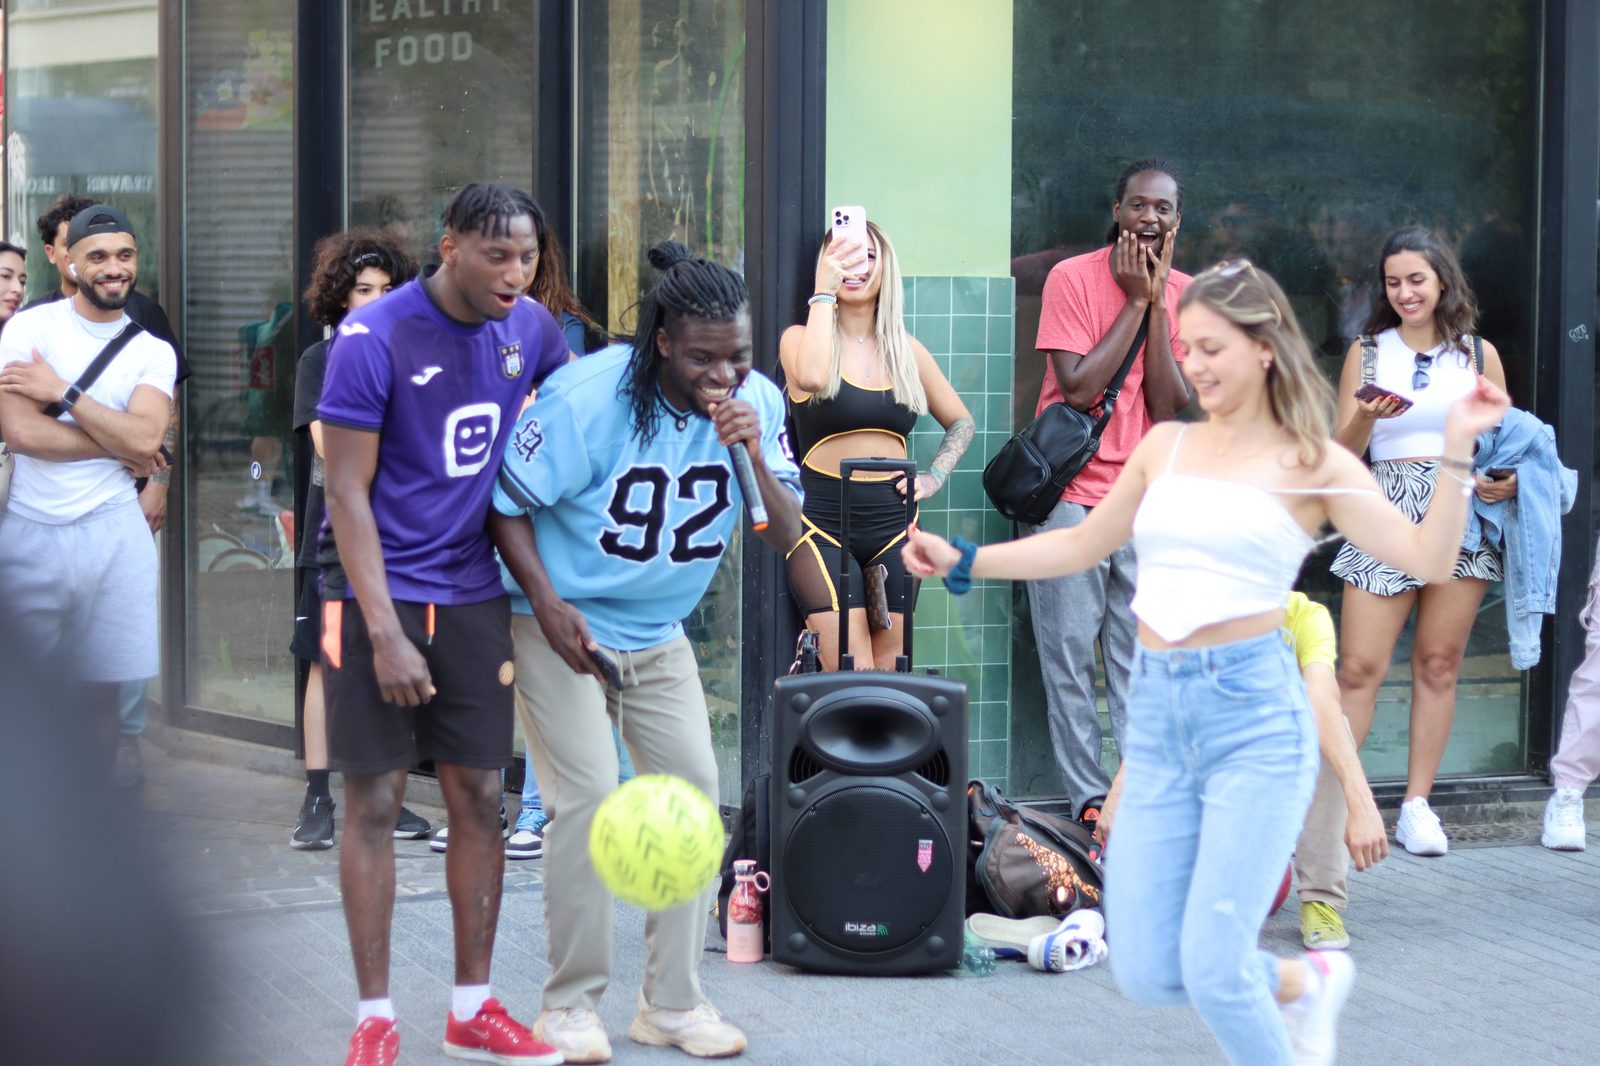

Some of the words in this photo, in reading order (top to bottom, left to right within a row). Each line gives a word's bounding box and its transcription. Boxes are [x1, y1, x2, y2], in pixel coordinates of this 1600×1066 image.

[375, 31, 473, 68] FOOD
[597, 461, 733, 564] 92
[1050, 944, 1061, 970] NIK
